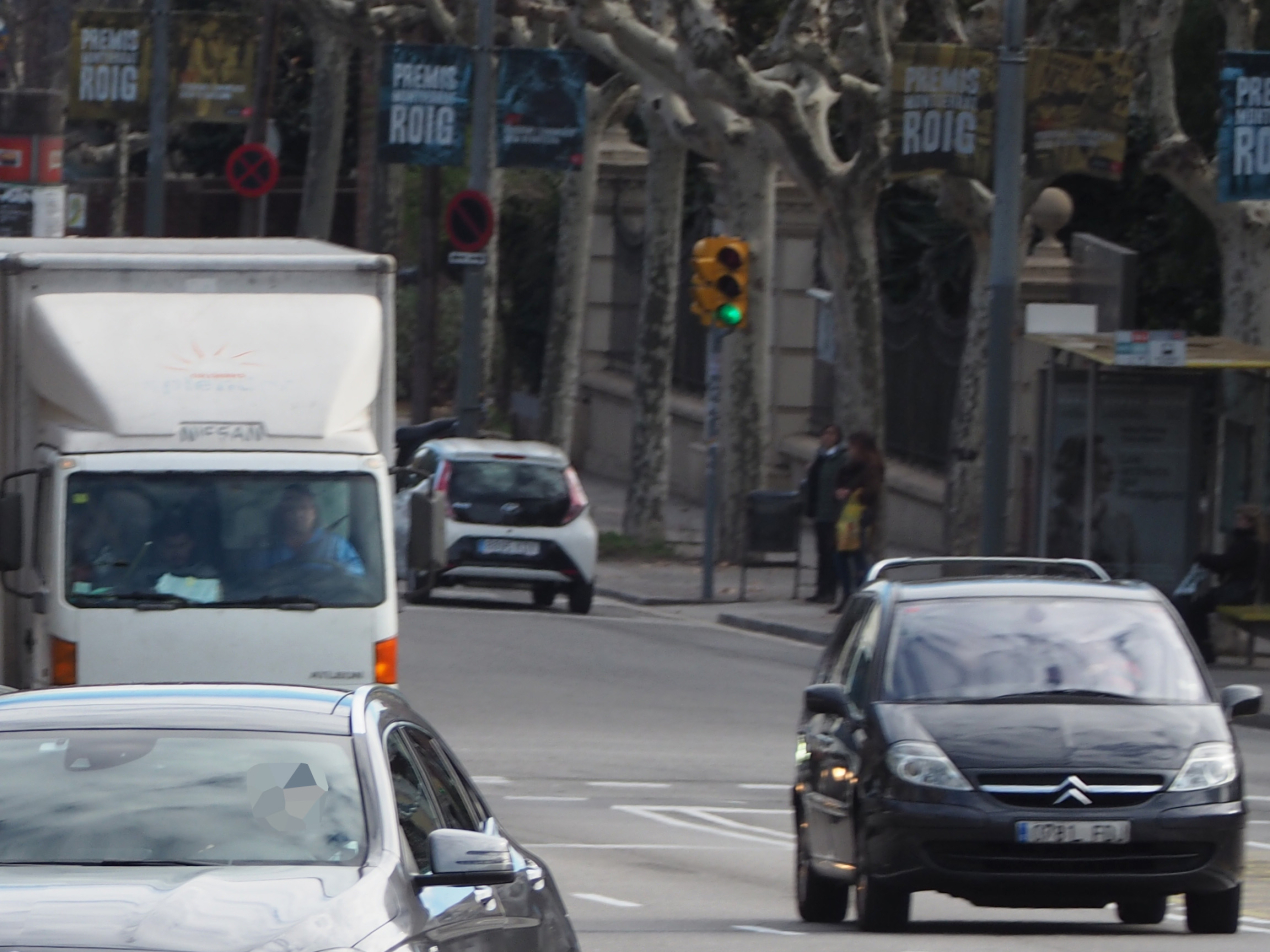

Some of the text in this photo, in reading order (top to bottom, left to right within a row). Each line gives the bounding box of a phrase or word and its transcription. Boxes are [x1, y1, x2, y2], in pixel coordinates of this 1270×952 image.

[80, 27, 139, 51] PREMIS
[79, 65, 138, 101] ROIG
[392, 63, 458, 90] PREMIS
[904, 66, 980, 94] PREMIS
[389, 105, 456, 145] ROIG
[902, 110, 977, 155] ROIG
[180, 424, 265, 442] NISSAN
